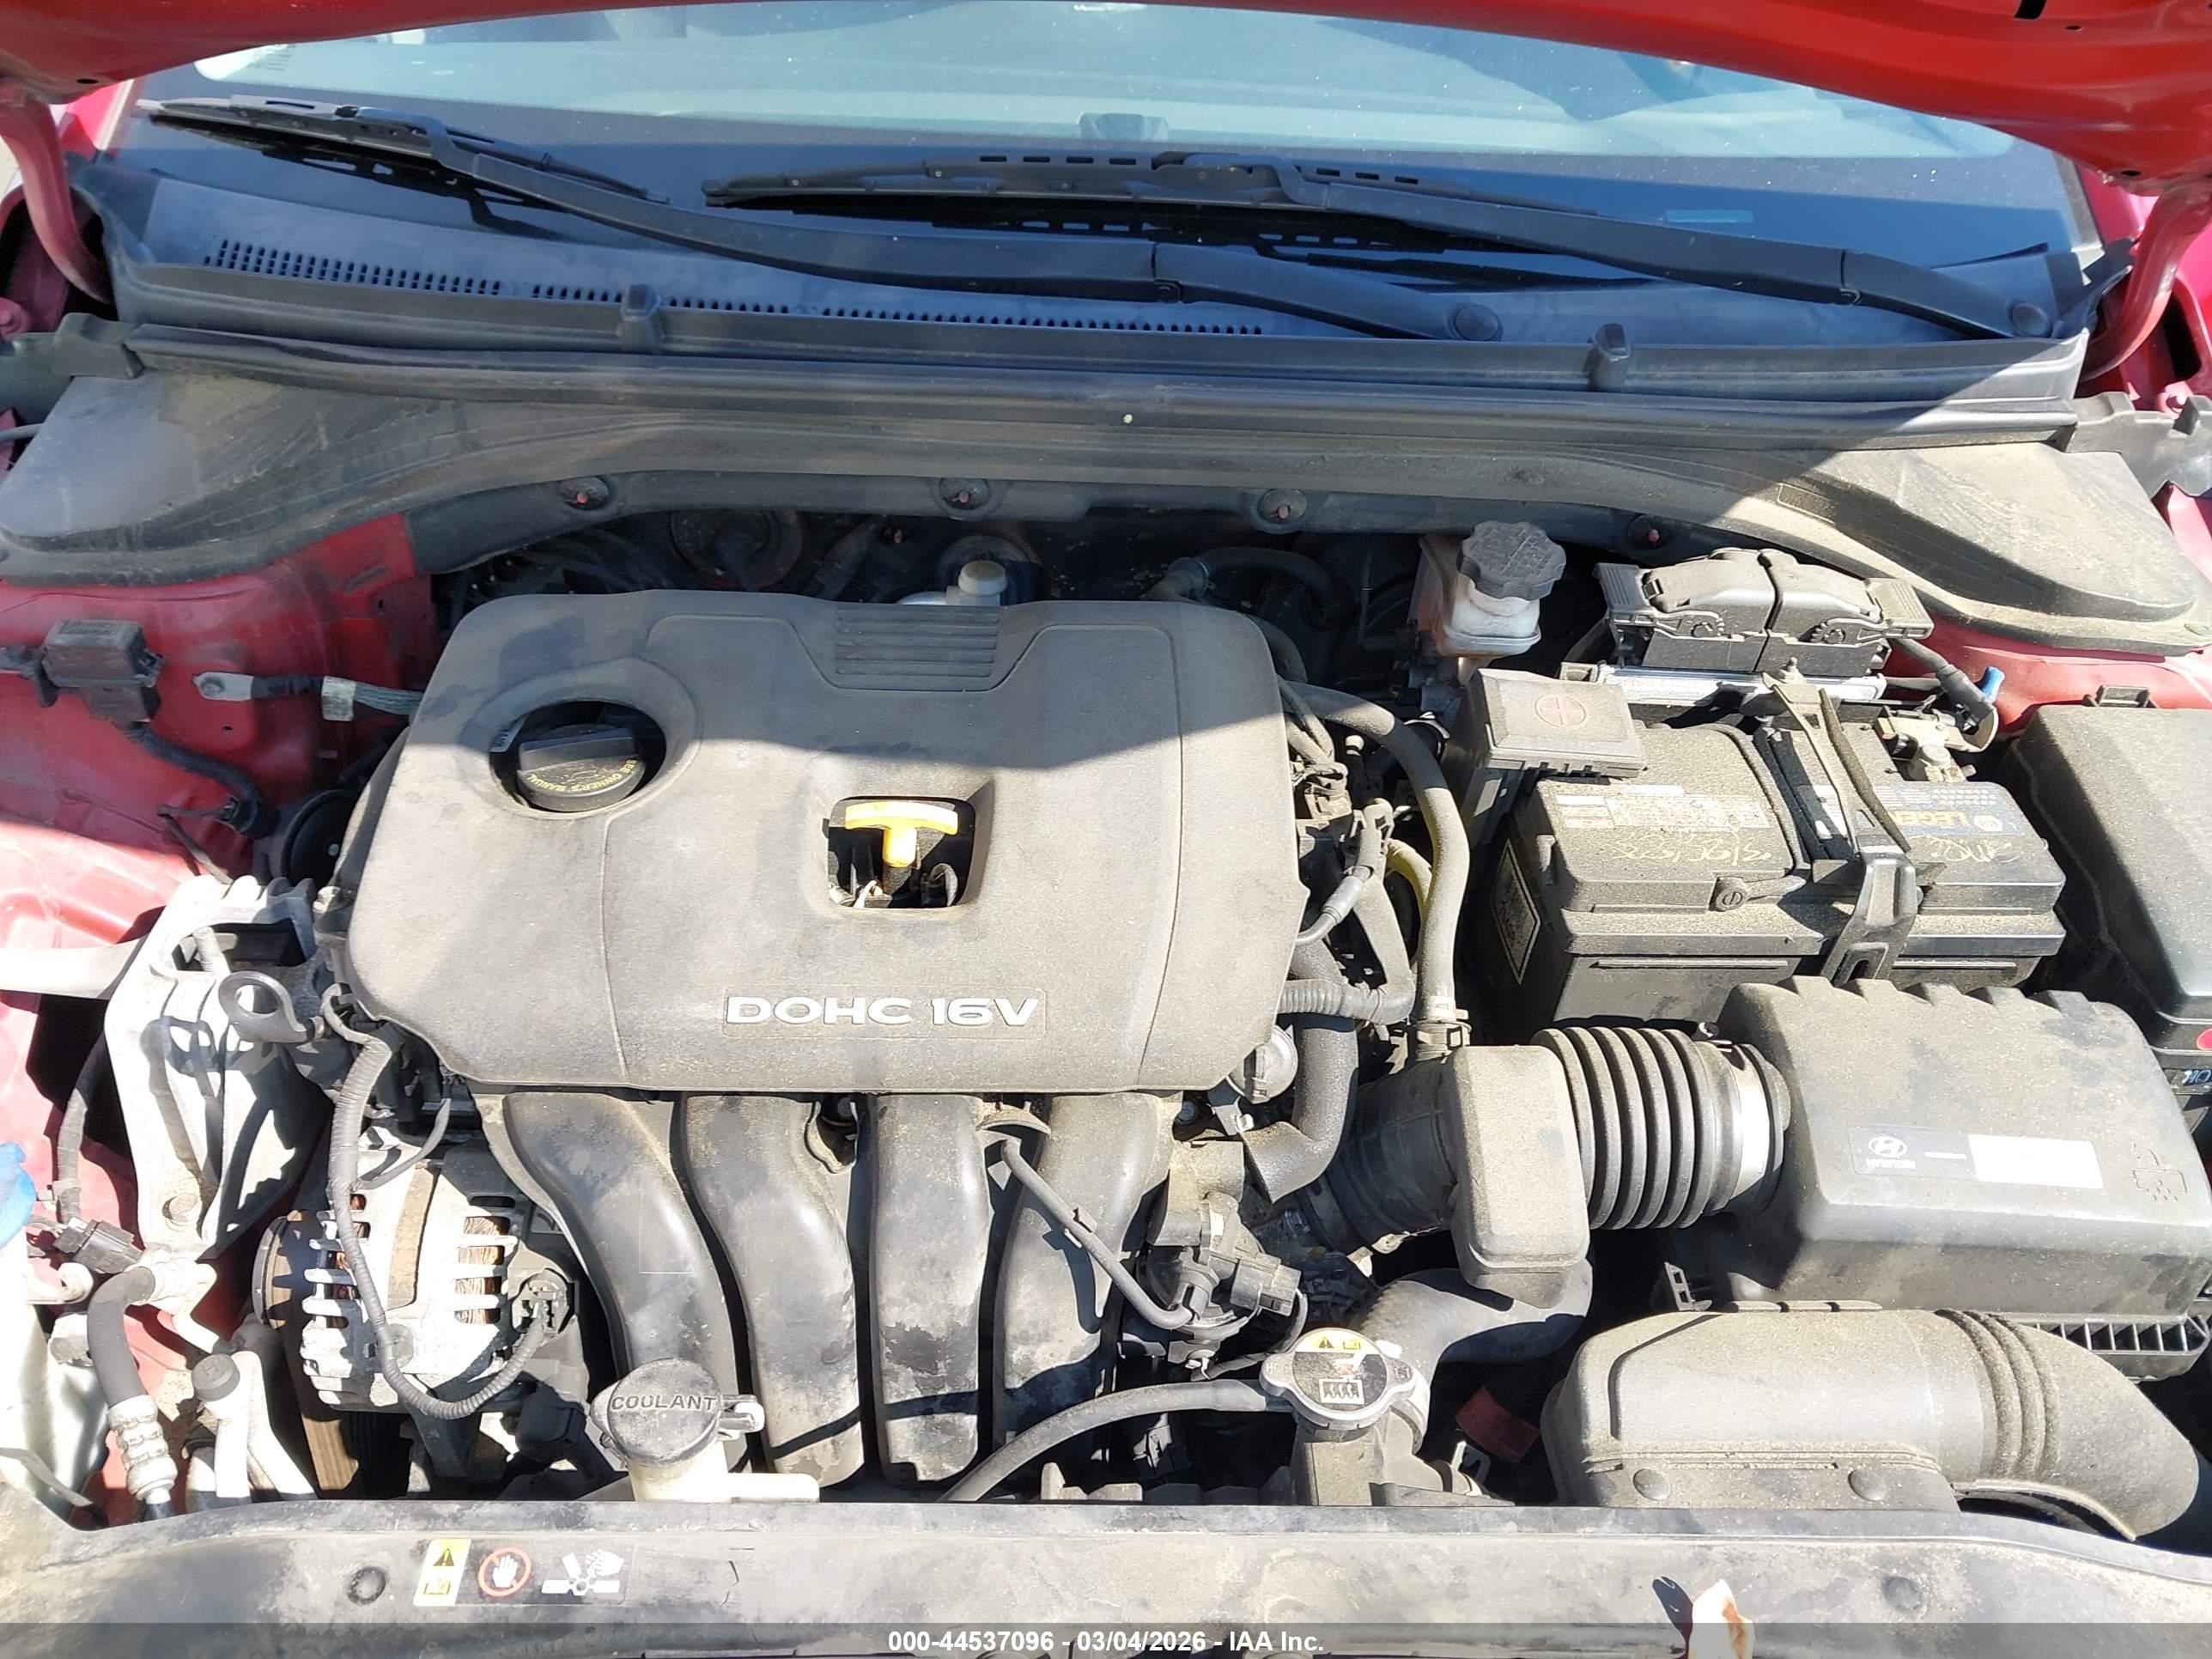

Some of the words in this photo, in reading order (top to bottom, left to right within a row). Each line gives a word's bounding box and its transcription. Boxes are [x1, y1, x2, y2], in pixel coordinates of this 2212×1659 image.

[726, 996, 912, 1024] DOHC
[931, 997, 1039, 1026] 16V
[611, 1394, 716, 1411] COOLANT
